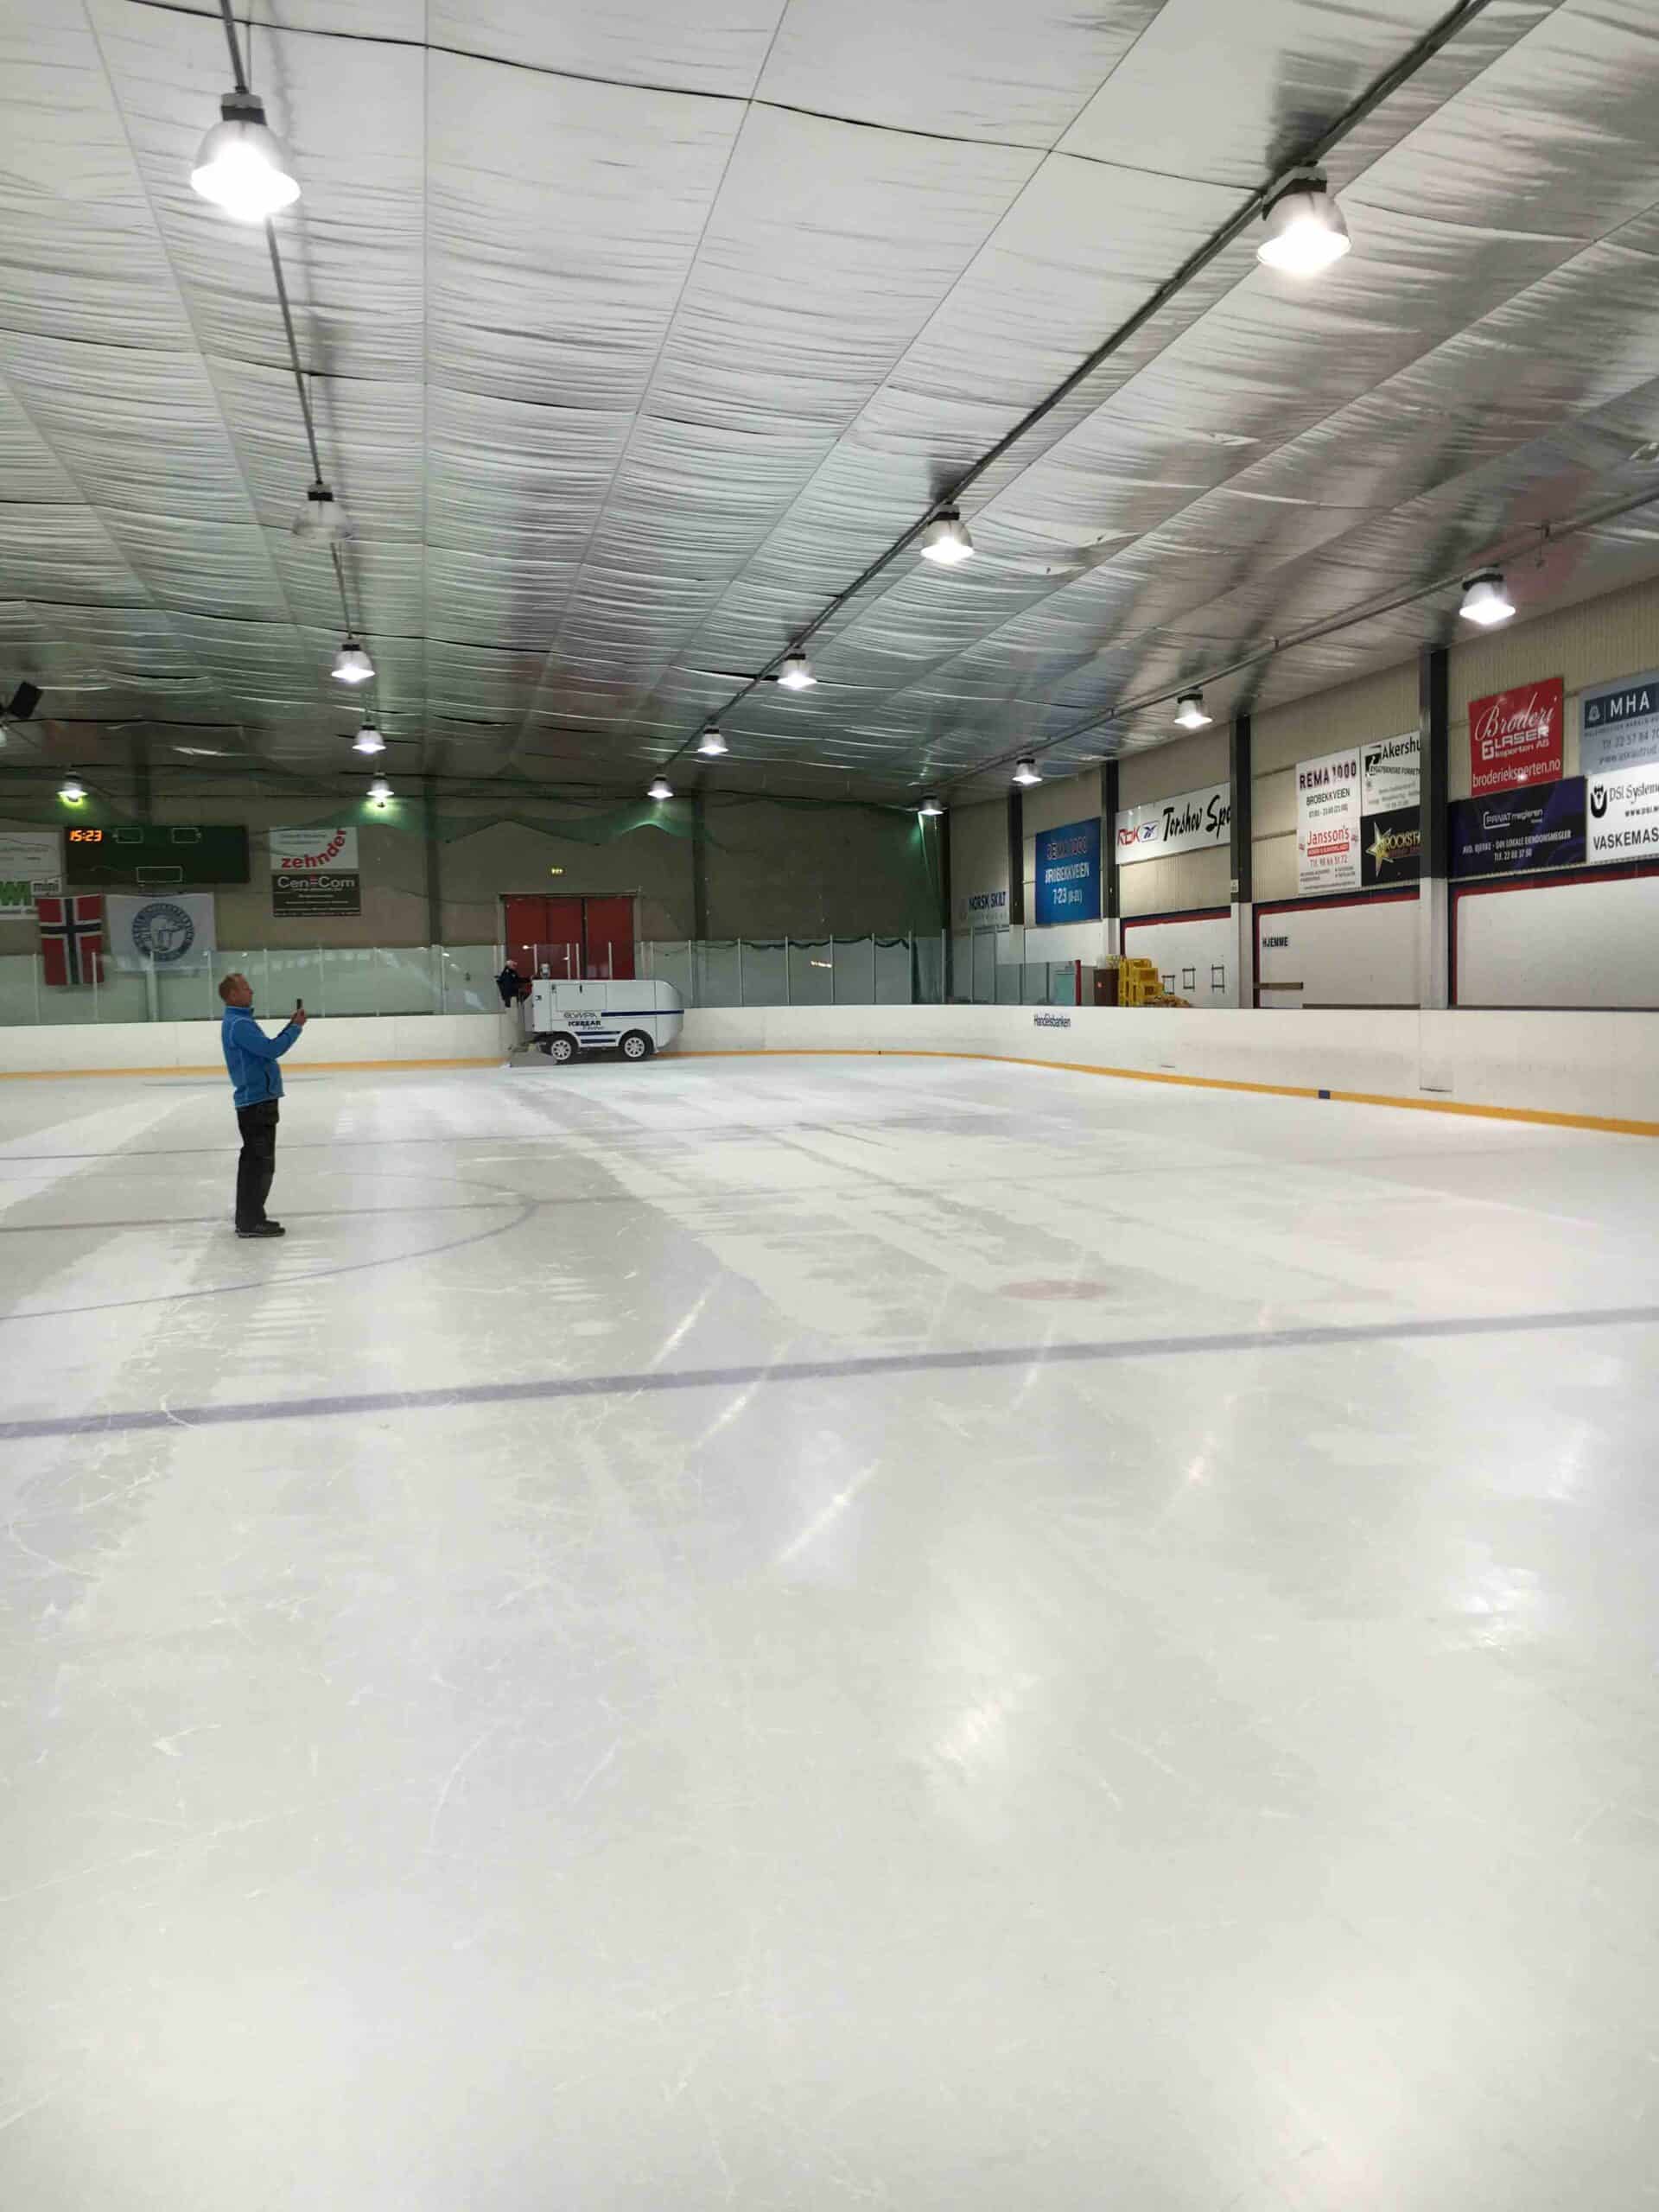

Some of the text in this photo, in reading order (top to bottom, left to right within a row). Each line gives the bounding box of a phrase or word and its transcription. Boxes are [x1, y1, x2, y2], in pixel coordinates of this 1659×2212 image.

[1610, 690, 1649, 718] MHA
[1299, 760, 1357, 791] REMA 1000
[69, 829, 103, 842] 15:23
[1306, 825, 1350, 845] Jansson's
[281, 829, 346, 868] zehnder
[1033, 1013, 1071, 1028] Handelsbanken
